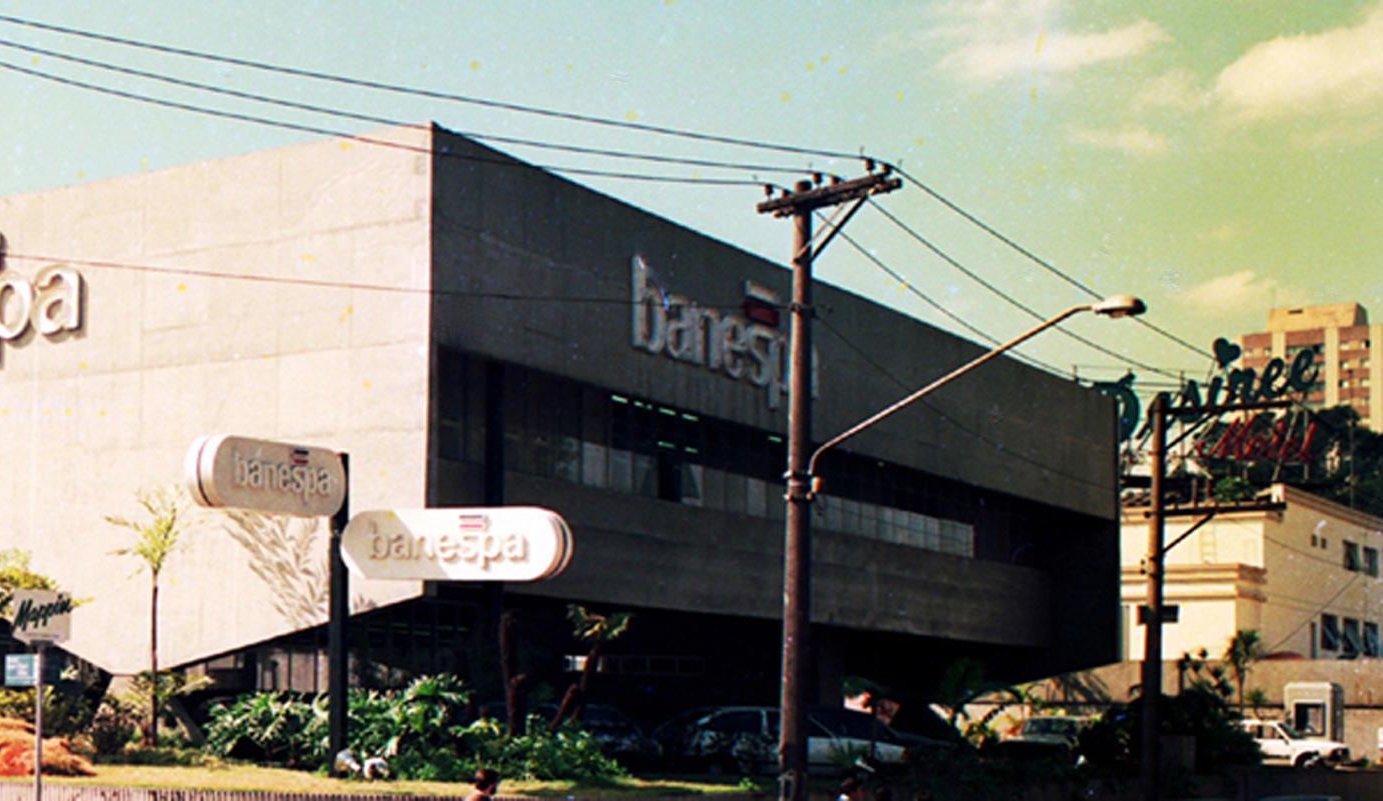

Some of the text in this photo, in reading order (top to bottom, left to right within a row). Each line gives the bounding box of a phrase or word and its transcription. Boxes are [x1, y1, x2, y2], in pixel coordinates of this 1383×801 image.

[632, 256, 817, 408] banesp
[233, 449, 331, 503] banespa
[368, 521, 527, 569] banespa
[12, 593, 71, 631] Mappin
